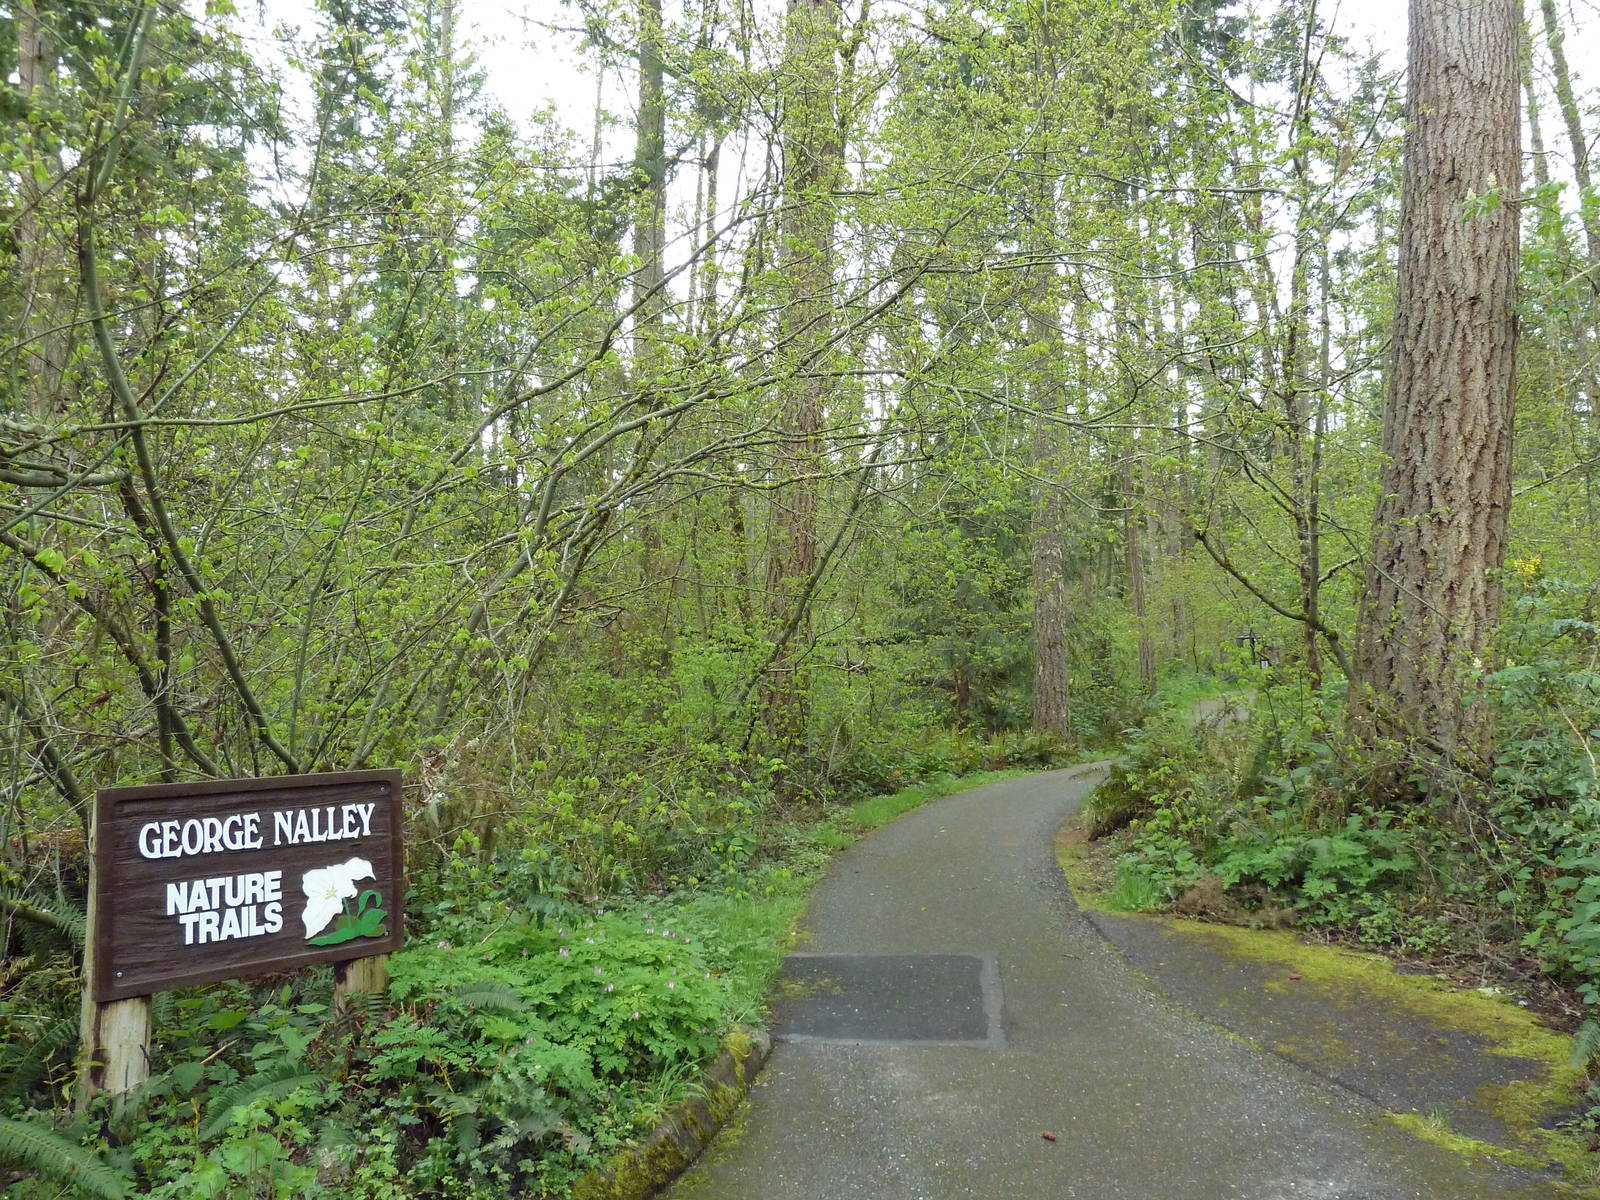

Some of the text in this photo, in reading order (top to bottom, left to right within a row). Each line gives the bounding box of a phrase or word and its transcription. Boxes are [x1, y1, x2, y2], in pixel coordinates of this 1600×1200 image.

[138, 803, 376, 859] GEORGE NALLEY
[166, 870, 283, 916] NATURE
[179, 901, 284, 945] TRAILS
